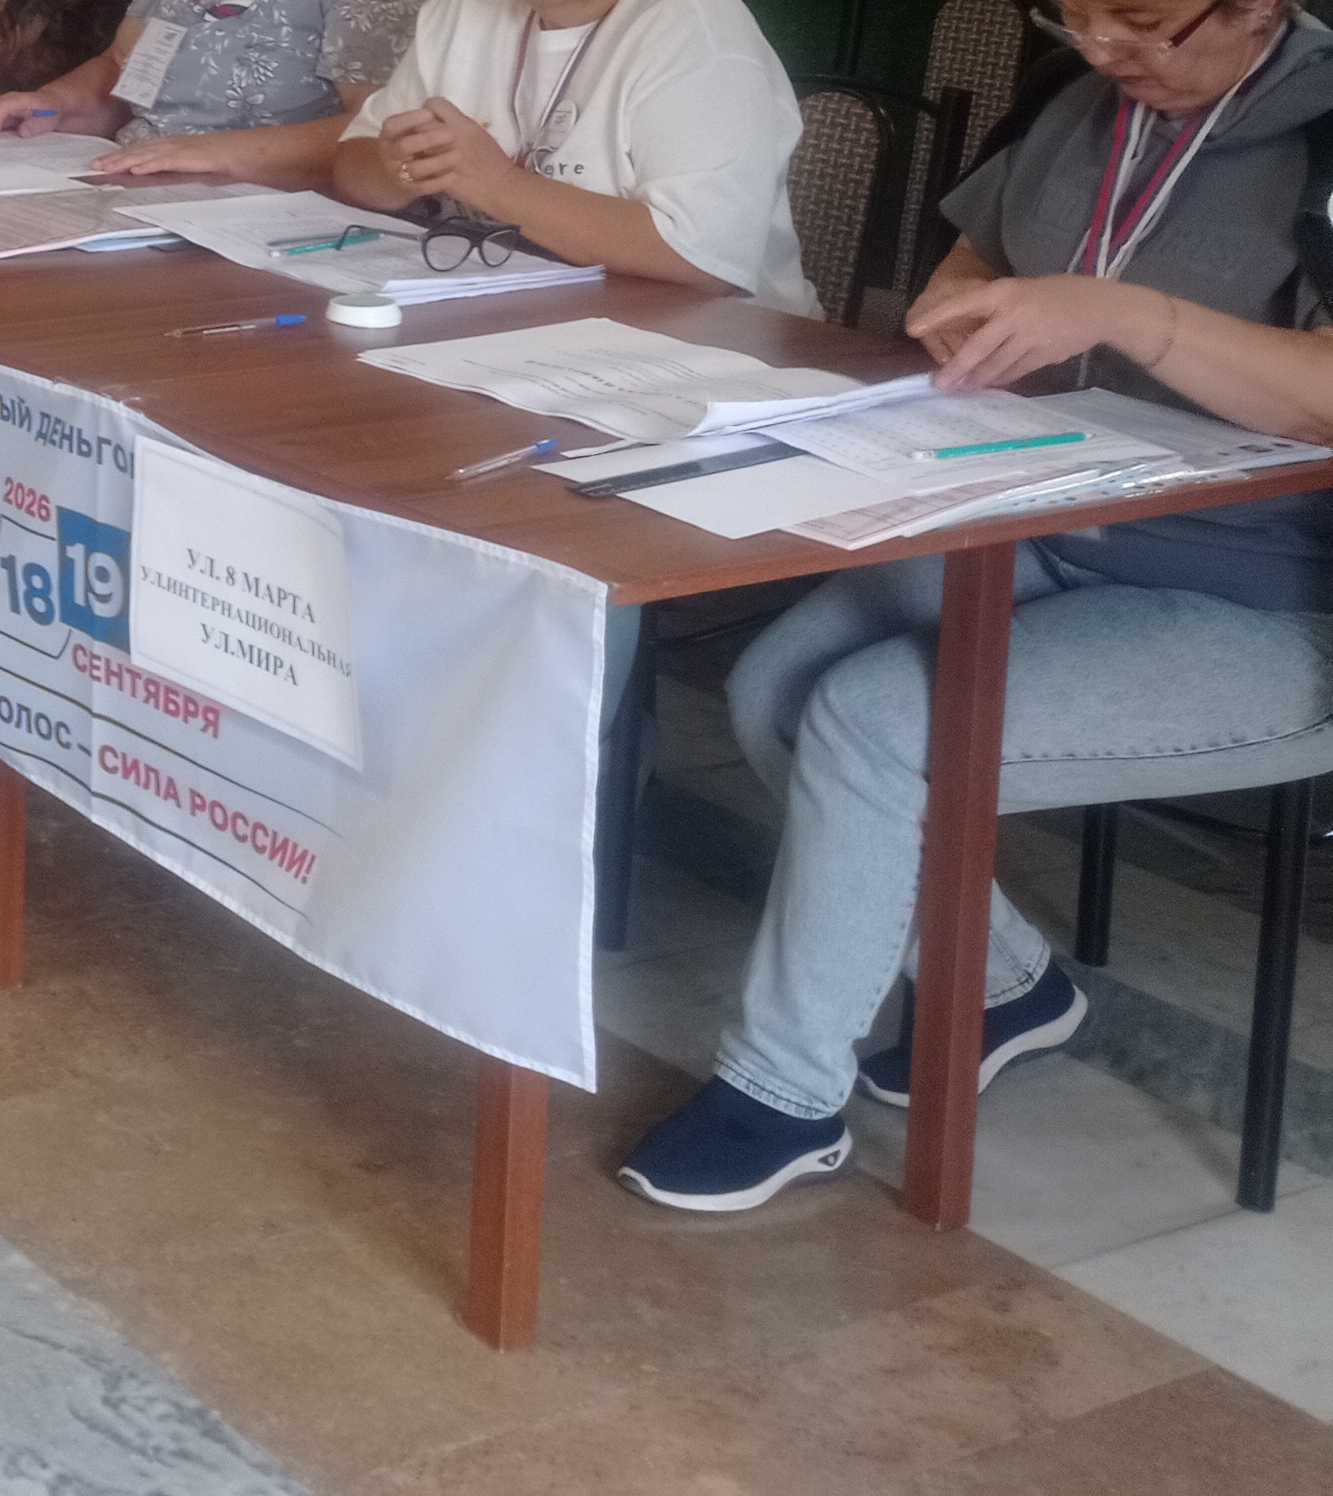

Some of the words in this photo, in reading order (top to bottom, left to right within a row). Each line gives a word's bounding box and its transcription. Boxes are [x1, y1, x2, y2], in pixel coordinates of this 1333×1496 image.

[34, 411, 93, 459] ДЕНЬ
[2, 475, 53, 523] 2026
[0, 553, 57, 628] 18
[65, 542, 126, 619] 19
[140, 565, 353, 678] УЛ.ИНТЕРНАЦИОНАЛЬНАЯ
[186, 548, 222, 581] УЛ.
[225, 564, 236, 587] 8
[241, 571, 317, 624] МАРТА
[71, 643, 221, 740] СЕНТЯБРЯ
[200, 622, 300, 687] УЛ.МИРА
[97, 744, 182, 809] СИЛА
[189, 787, 316, 885] РОССИИ!
